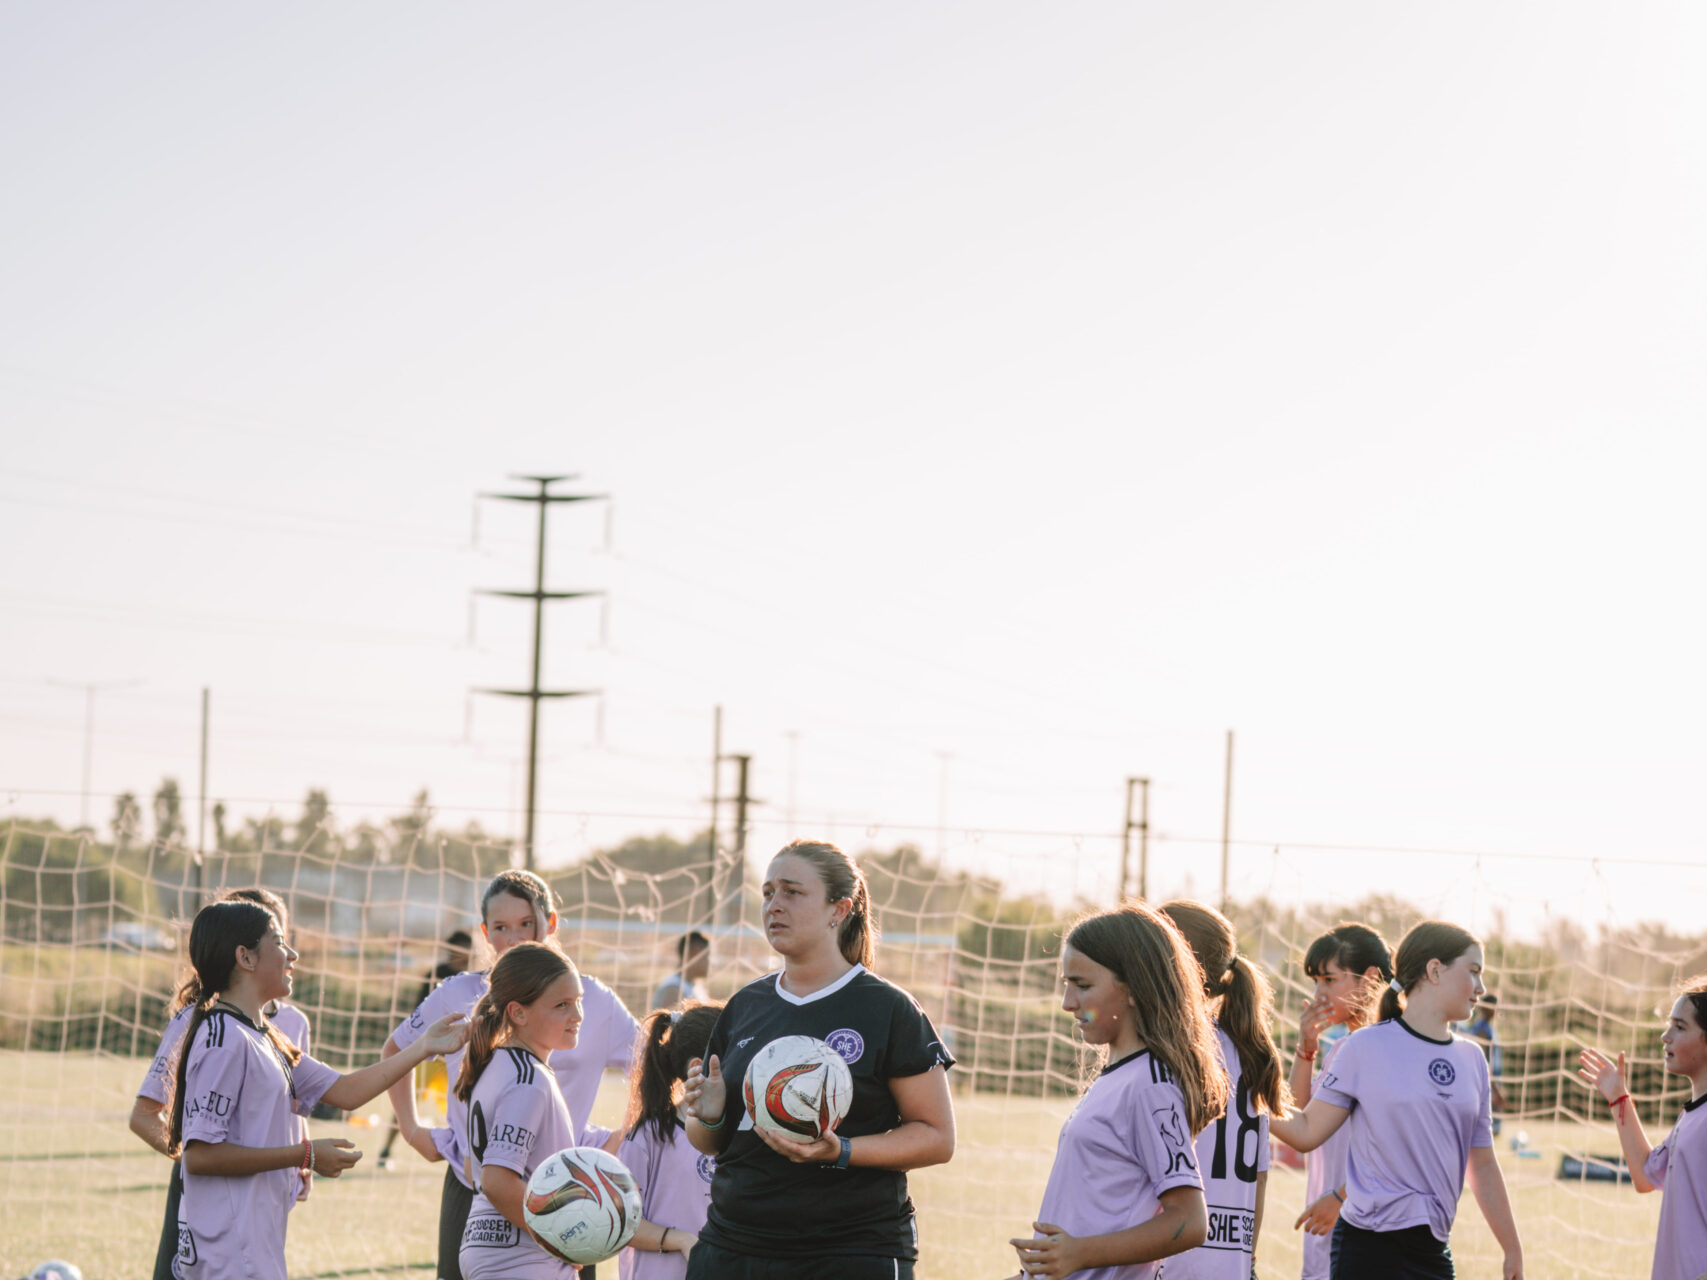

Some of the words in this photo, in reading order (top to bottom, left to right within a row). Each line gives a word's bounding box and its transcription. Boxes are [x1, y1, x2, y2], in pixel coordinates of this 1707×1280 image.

[837, 1041, 853, 1052] SHE
[1211, 1073, 1260, 1183] 18
[1207, 1212, 1241, 1243] SHE
